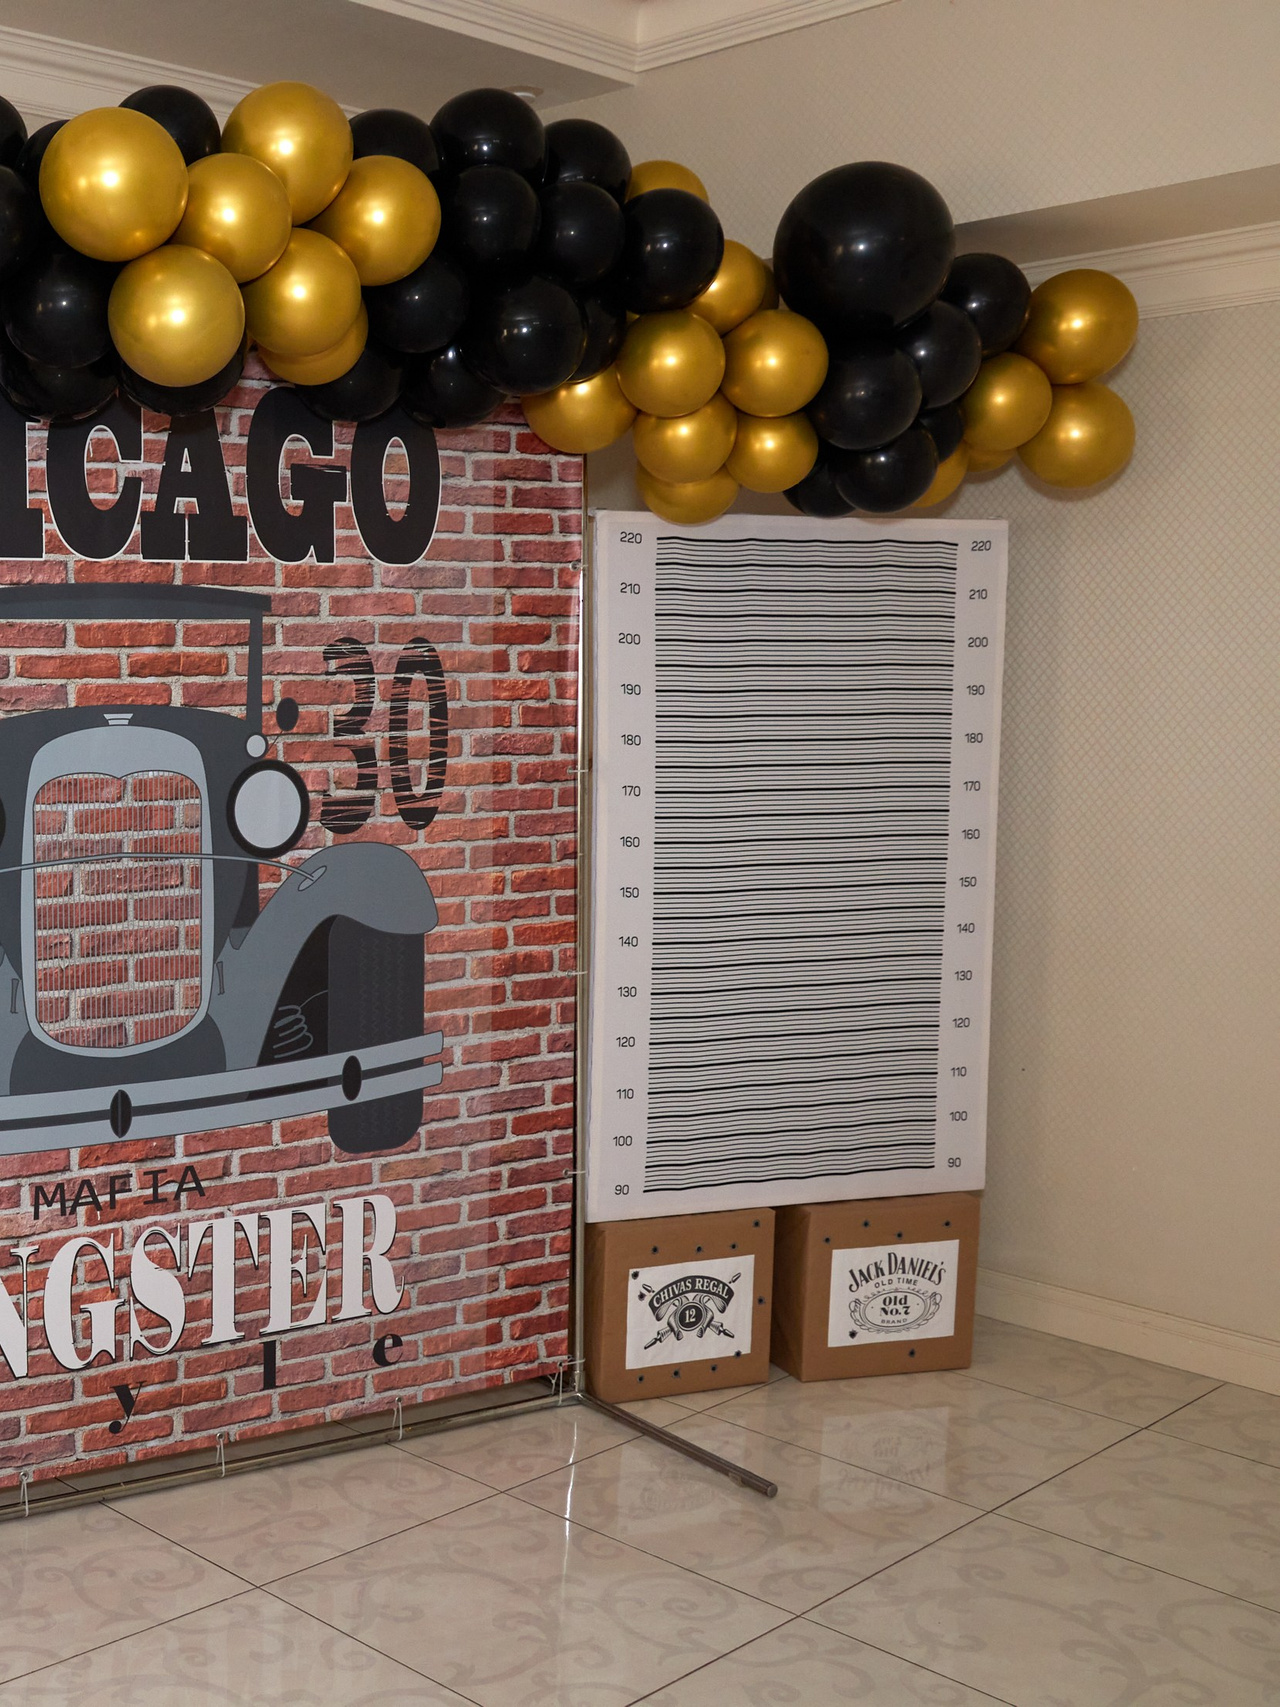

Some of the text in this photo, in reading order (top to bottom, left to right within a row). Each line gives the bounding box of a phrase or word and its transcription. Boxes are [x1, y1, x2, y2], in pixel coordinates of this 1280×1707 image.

[619, 531, 643, 545] 220
[970, 539, 992, 552] 220
[620, 581, 641, 595] 210
[968, 588, 988, 600] 210
[618, 632, 641, 646] 200
[967, 636, 989, 648] 200
[620, 683, 642, 696] 190
[966, 684, 985, 696] 190
[320, 636, 449, 835] 30
[620, 734, 642, 746] 180
[964, 732, 984, 744] 180
[621, 785, 641, 797] 170
[963, 780, 981, 792] 170
[961, 828, 981, 840] 160
[619, 836, 641, 848] 160
[959, 876, 977, 888] 150
[619, 886, 640, 899] 150
[956, 922, 975, 934] 140
[618, 935, 639, 948] 140
[954, 969, 973, 981] 130
[617, 986, 637, 998] 130
[952, 1017, 971, 1029] 120
[615, 1036, 636, 1048] 120
[950, 1066, 967, 1077] 110
[616, 1088, 635, 1100] 110
[949, 1110, 968, 1122] 100
[612, 1135, 633, 1147] 100
[947, 1156, 962, 1168] 90
[31, 1165, 207, 1221] MAFIA
[614, 1184, 630, 1196] 90
[848, 1251, 947, 1293] JACK DANIEL'S
[874, 1277, 919, 1289] OLD TIME
[652, 1278, 730, 1308] CHIVAS REGAL
[882, 1295, 908, 1307] Old
[684, 1308, 697, 1323] 12
